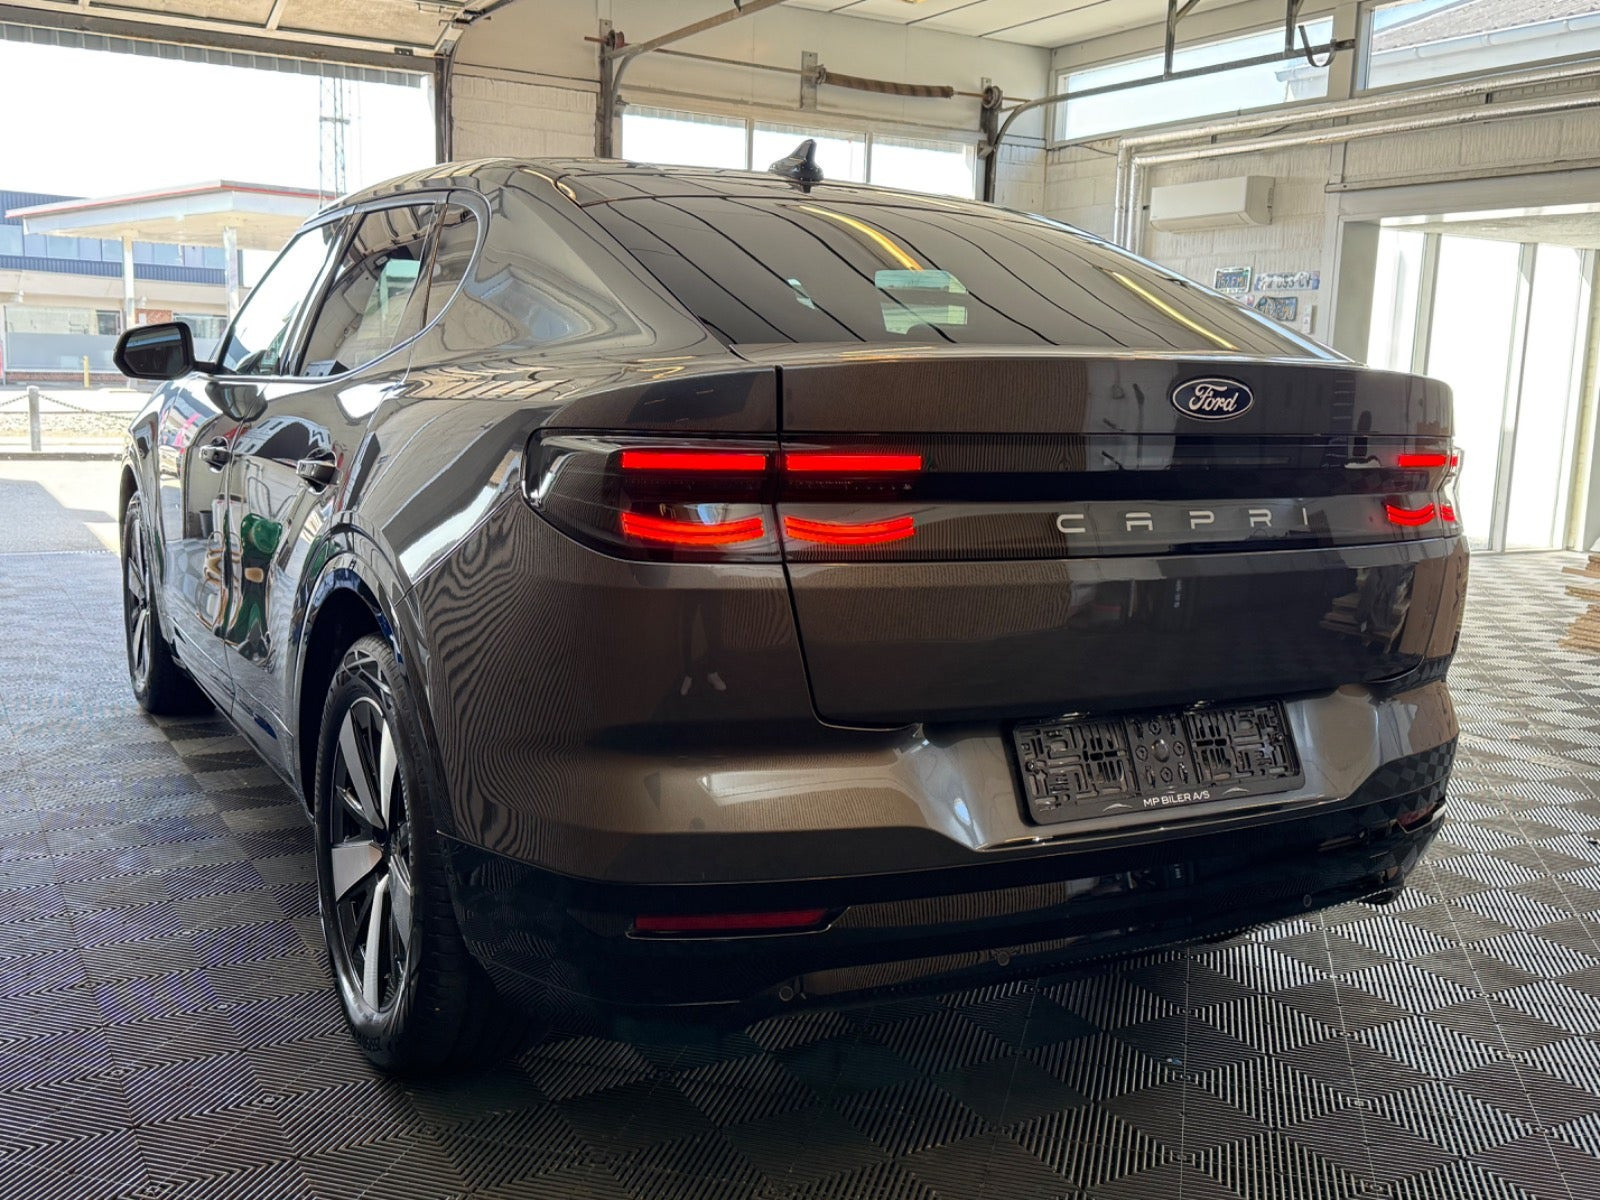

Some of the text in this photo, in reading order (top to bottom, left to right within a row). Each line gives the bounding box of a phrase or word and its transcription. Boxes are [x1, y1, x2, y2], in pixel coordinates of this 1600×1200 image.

[1188, 383, 1239, 412] Ford
[1056, 507, 1309, 533] CAPRI
[1143, 790, 1210, 808] MP BILER A/S
